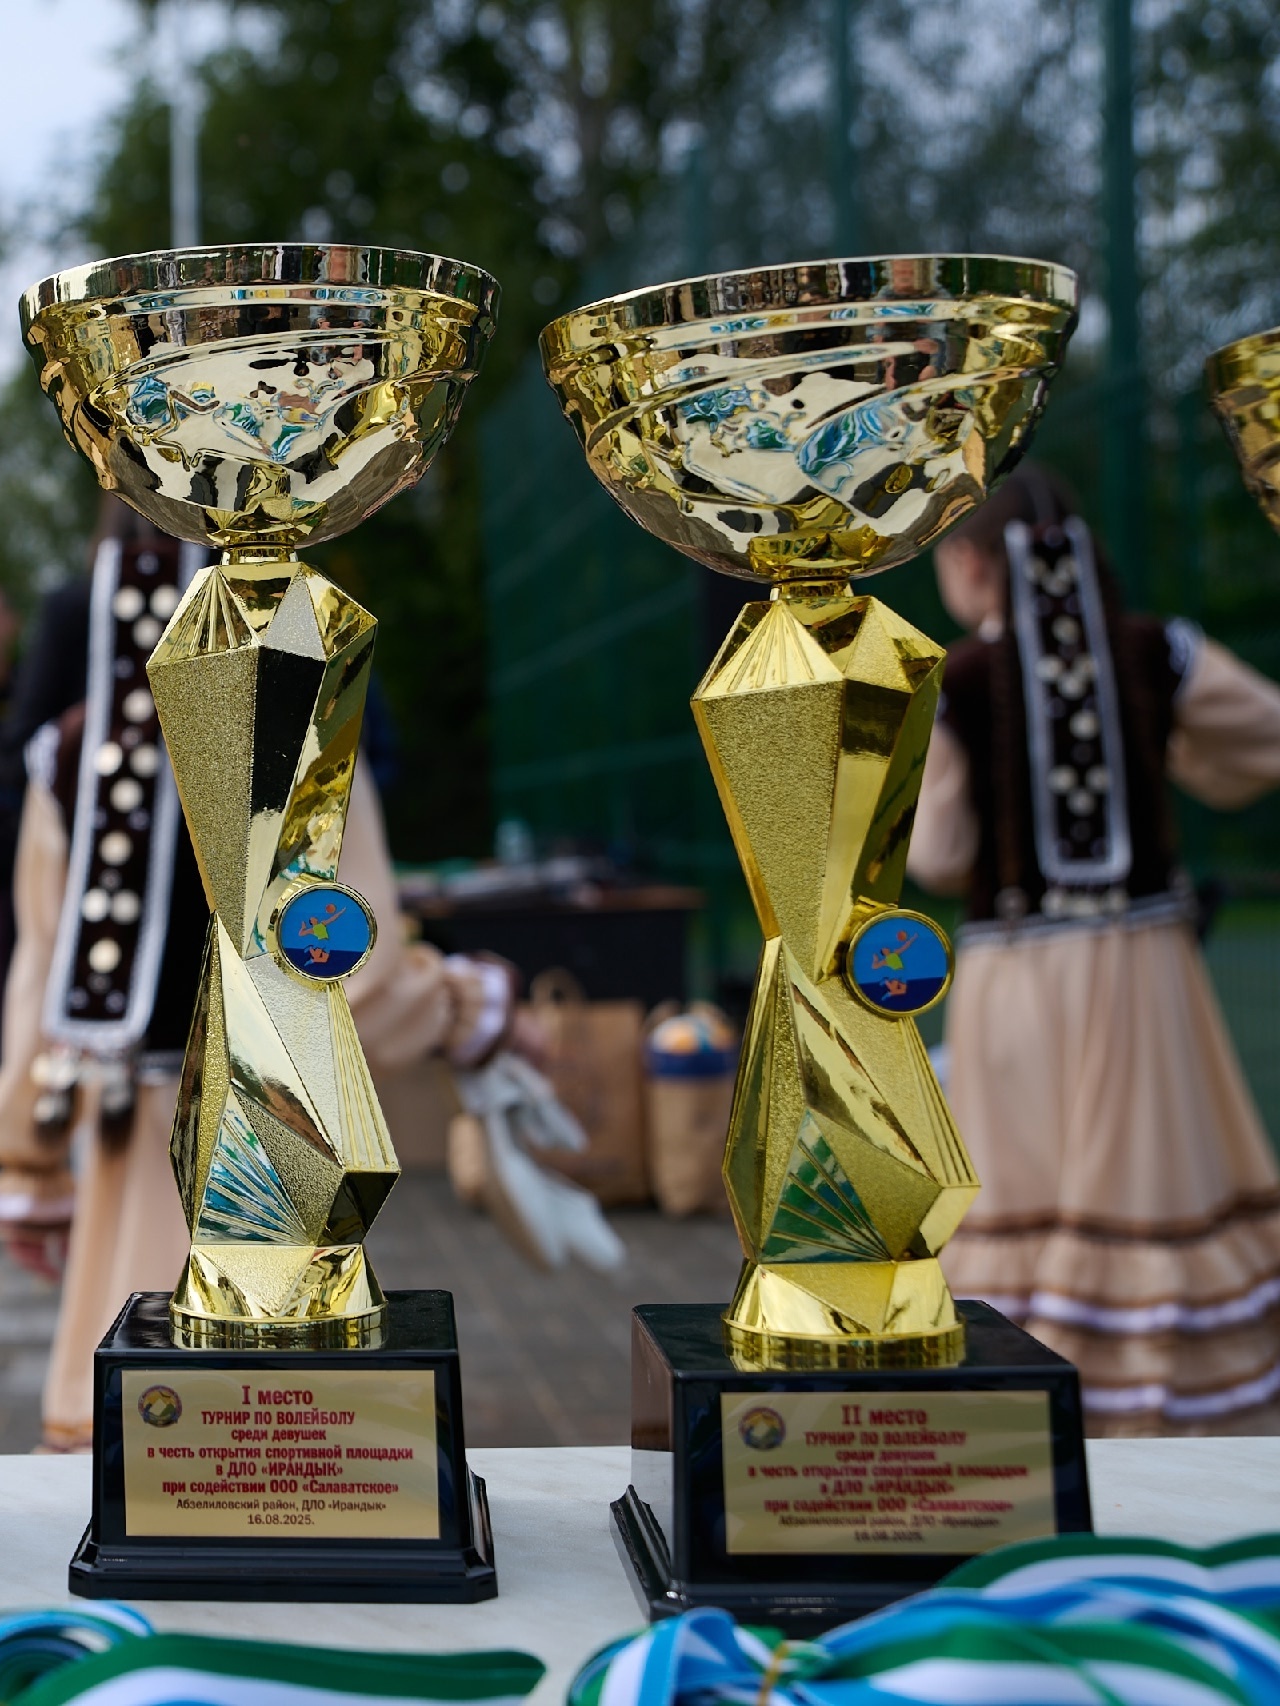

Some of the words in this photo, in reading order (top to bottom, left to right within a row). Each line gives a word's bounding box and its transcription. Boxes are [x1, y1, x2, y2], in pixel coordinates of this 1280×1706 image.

[242, 1385, 250, 1404] I
[258, 1388, 313, 1404] место
[201, 1411, 250, 1424] ТУРНИР
[254, 1411, 271, 1424] ПО
[277, 1408, 355, 1425] ВОЛЕЙБОЛУ
[841, 1405, 862, 1425] II
[869, 1409, 927, 1425] место
[231, 1429, 267, 1442] среди
[272, 1429, 326, 1442] девушек
[805, 1431, 856, 1445] ТУРНИР
[860, 1431, 878, 1445] ПО
[148, 1448, 154, 1458] в
[159, 1447, 194, 1458] честь
[200, 1448, 260, 1460] открытия
[265, 1444, 341, 1460] спортивной
[346, 1448, 413, 1460] площадки
[216, 1466, 222, 1476] в
[227, 1462, 256, 1478] ДЛО
[261, 1461, 343, 1478] «ИРАНДЫК»
[163, 1482, 185, 1495] при
[190, 1480, 265, 1494] содействии
[270, 1480, 298, 1493] ООО
[302, 1480, 398, 1494] «Салаватское»
[833, 1480, 863, 1495] ДЛО
[176, 1499, 259, 1510] Абзелиловский
[262, 1500, 298, 1512] район,
[302, 1500, 325, 1511] ДЛО
[328, 1500, 386, 1512] «Ирандык»
[248, 1515, 315, 1525] 16.08.2025.
